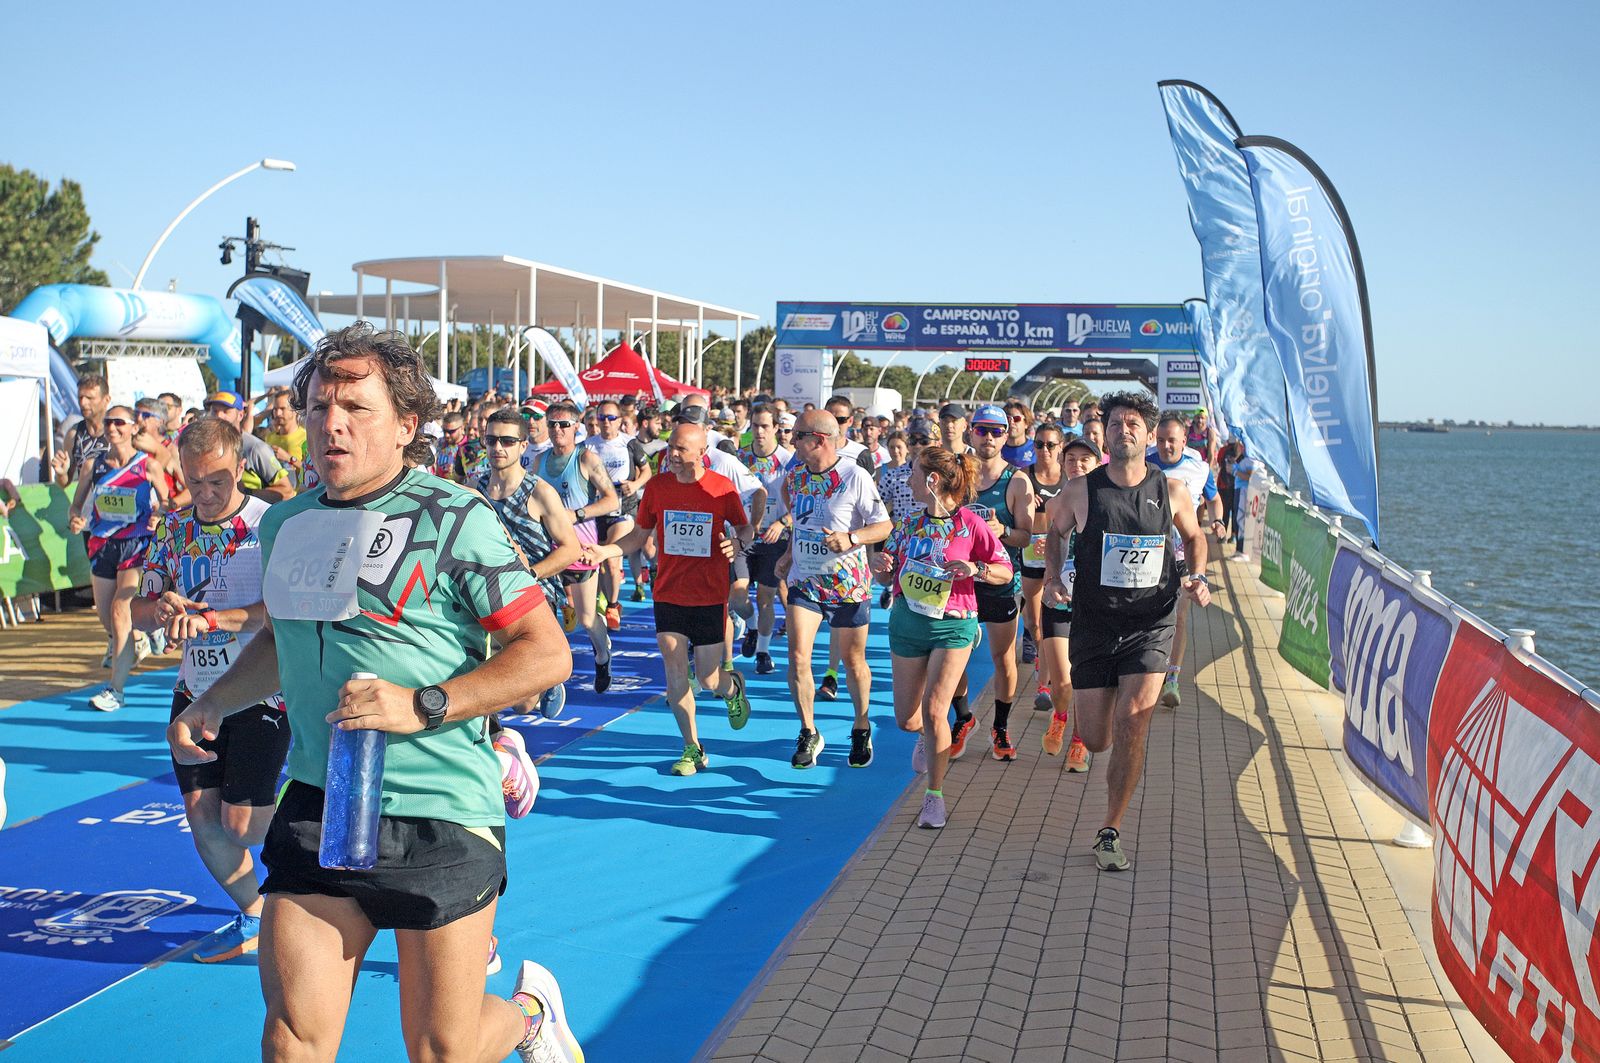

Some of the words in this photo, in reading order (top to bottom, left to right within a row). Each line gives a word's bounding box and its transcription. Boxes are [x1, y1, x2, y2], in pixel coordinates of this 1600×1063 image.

[923, 309, 1020, 320] CAMPEONATO
[842, 311, 864, 341] 10
[922, 325, 937, 335] de
[940, 322, 989, 335] ESPAÑA
[996, 322, 1019, 337] 10
[1024, 321, 1054, 338] km
[1066, 313, 1092, 345] 10
[1091, 320, 1131, 332] HUELVA
[1165, 322, 1194, 334] WiH
[986, 338, 1019, 346] Absoluto
[104, 495, 124, 507] 831
[671, 523, 704, 536] 1578
[798, 541, 828, 556] 1196
[1143, 539, 1160, 547] 2023
[1119, 549, 1150, 564] 727
[212, 578, 228, 590] VA
[907, 573, 942, 596] 1904
[212, 632, 230, 643] 2023
[190, 647, 230, 667] 1851
